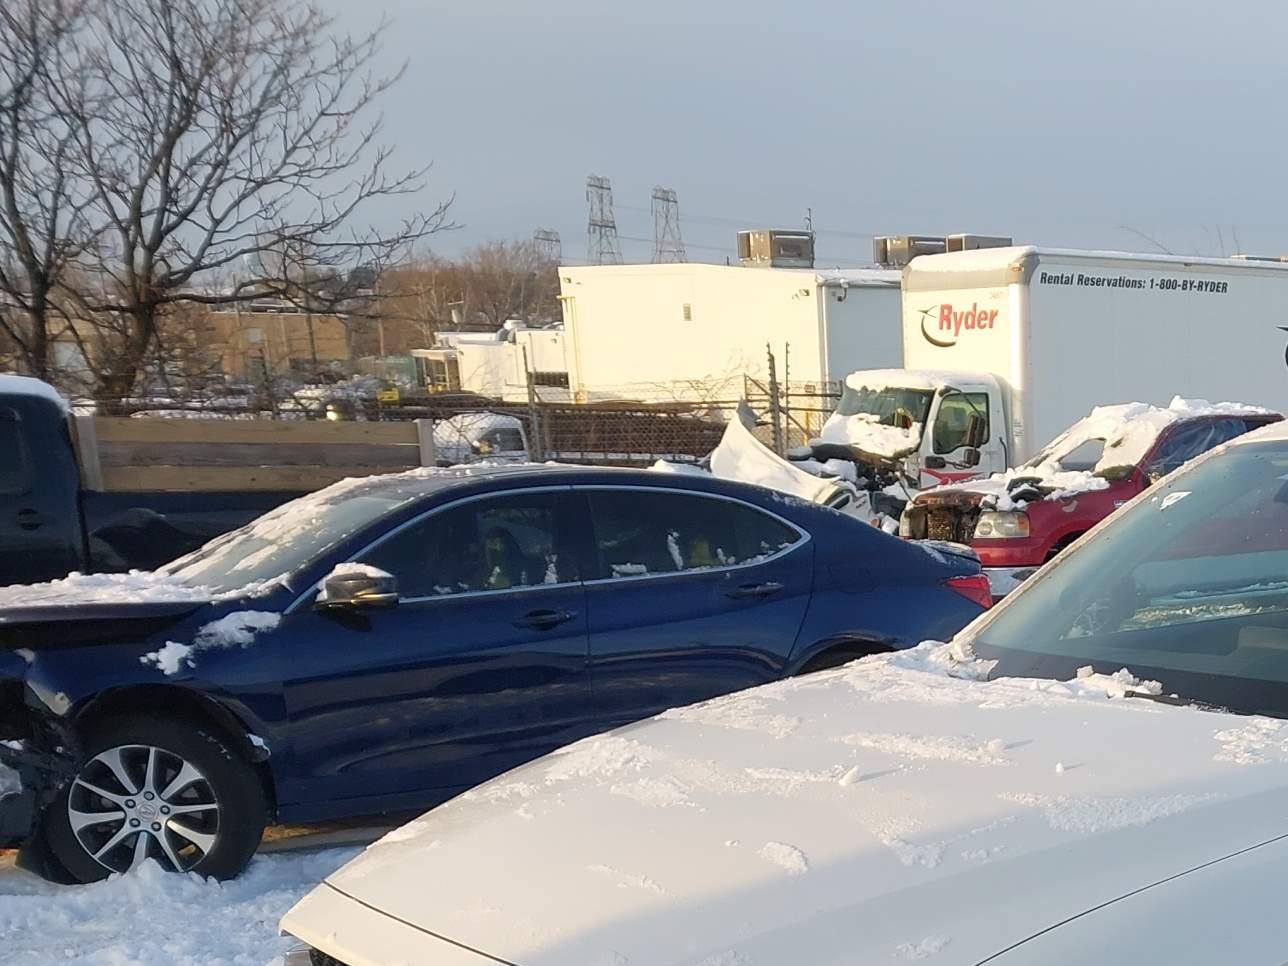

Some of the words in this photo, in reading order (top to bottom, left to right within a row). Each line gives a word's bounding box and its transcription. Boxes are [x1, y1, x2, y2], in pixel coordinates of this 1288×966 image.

[1040, 272, 1074, 285] Rental
[1077, 274, 1146, 289] Reservations:
[1149, 278, 1228, 293] 1-800-BY-RYDER
[938, 302, 999, 337] Ryder
